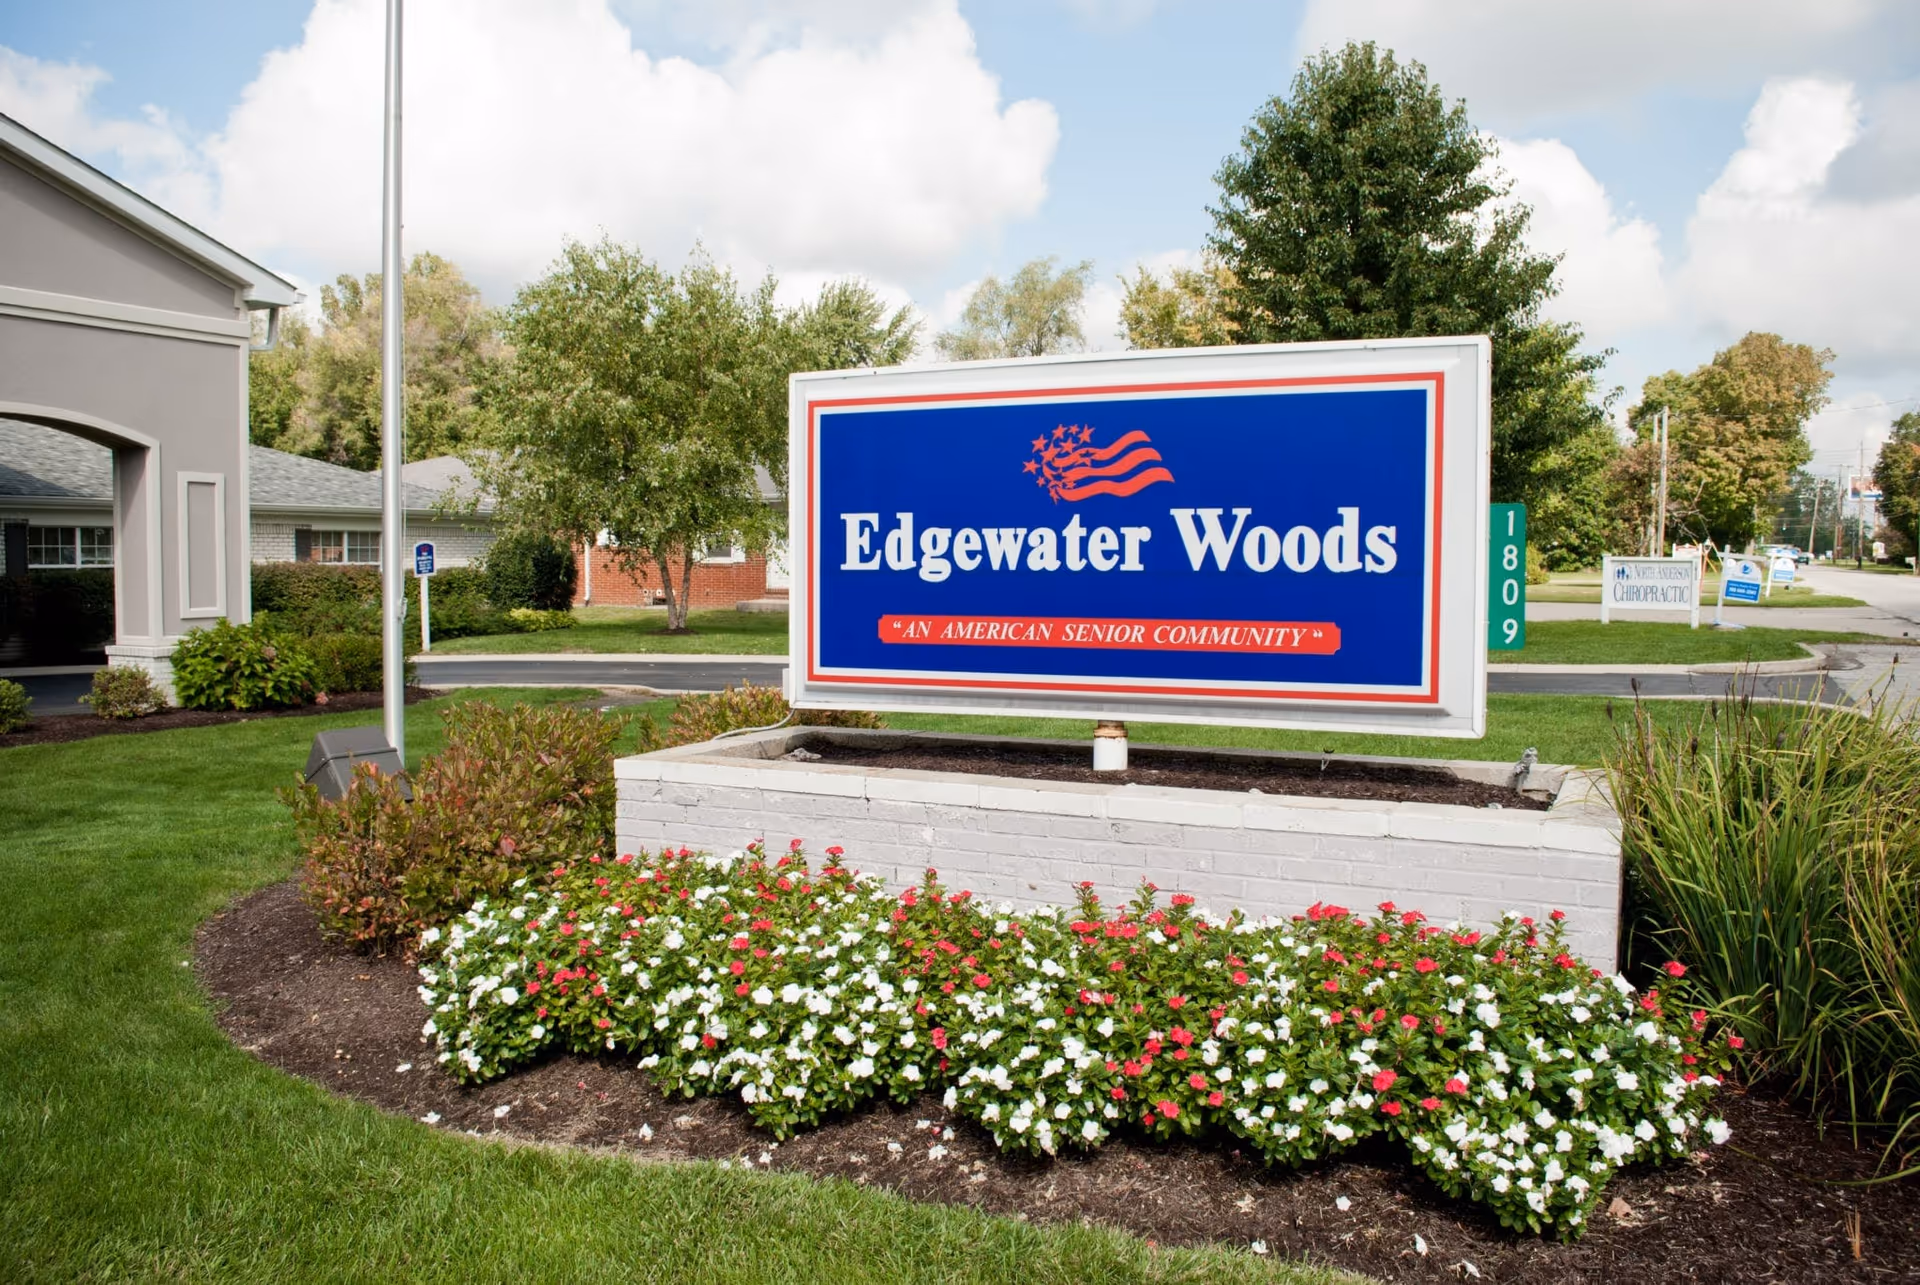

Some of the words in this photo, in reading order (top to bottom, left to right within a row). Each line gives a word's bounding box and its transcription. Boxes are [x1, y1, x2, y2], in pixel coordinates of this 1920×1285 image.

[840, 512, 1152, 583] Edgewater
[1169, 506, 1398, 574] Woods
[1502, 510, 1519, 644] 1809
[1613, 582, 1689, 603] CHIROPRACTIC
[940, 621, 1053, 641] AMERICAN
[1062, 624, 1146, 643] SENIOR
